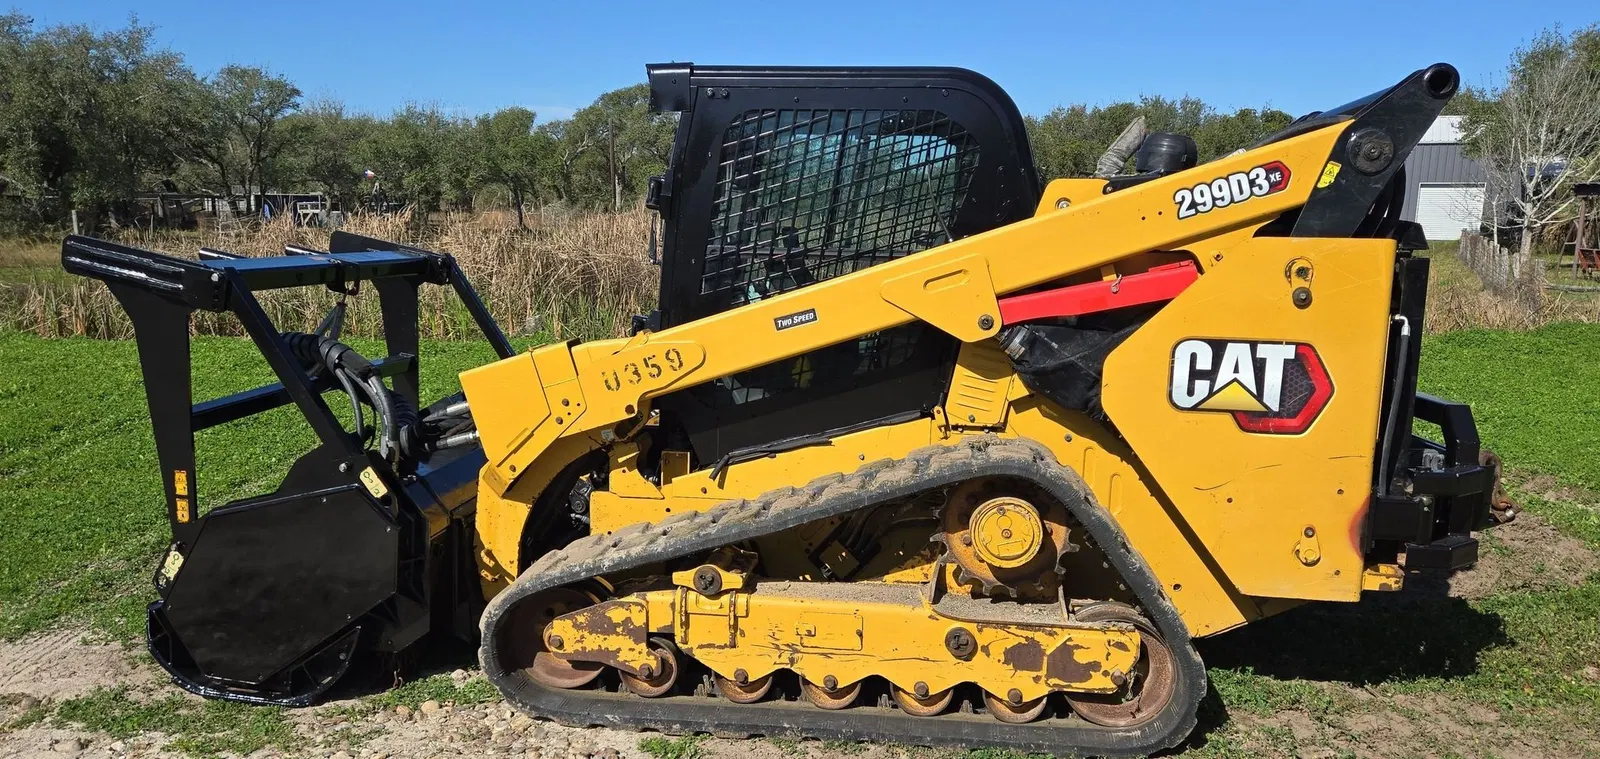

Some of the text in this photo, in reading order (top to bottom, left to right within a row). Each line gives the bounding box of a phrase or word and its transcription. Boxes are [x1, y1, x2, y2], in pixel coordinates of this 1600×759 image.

[1174, 166, 1283, 219] 299D3 XE
[1172, 339, 1297, 413] CAT
